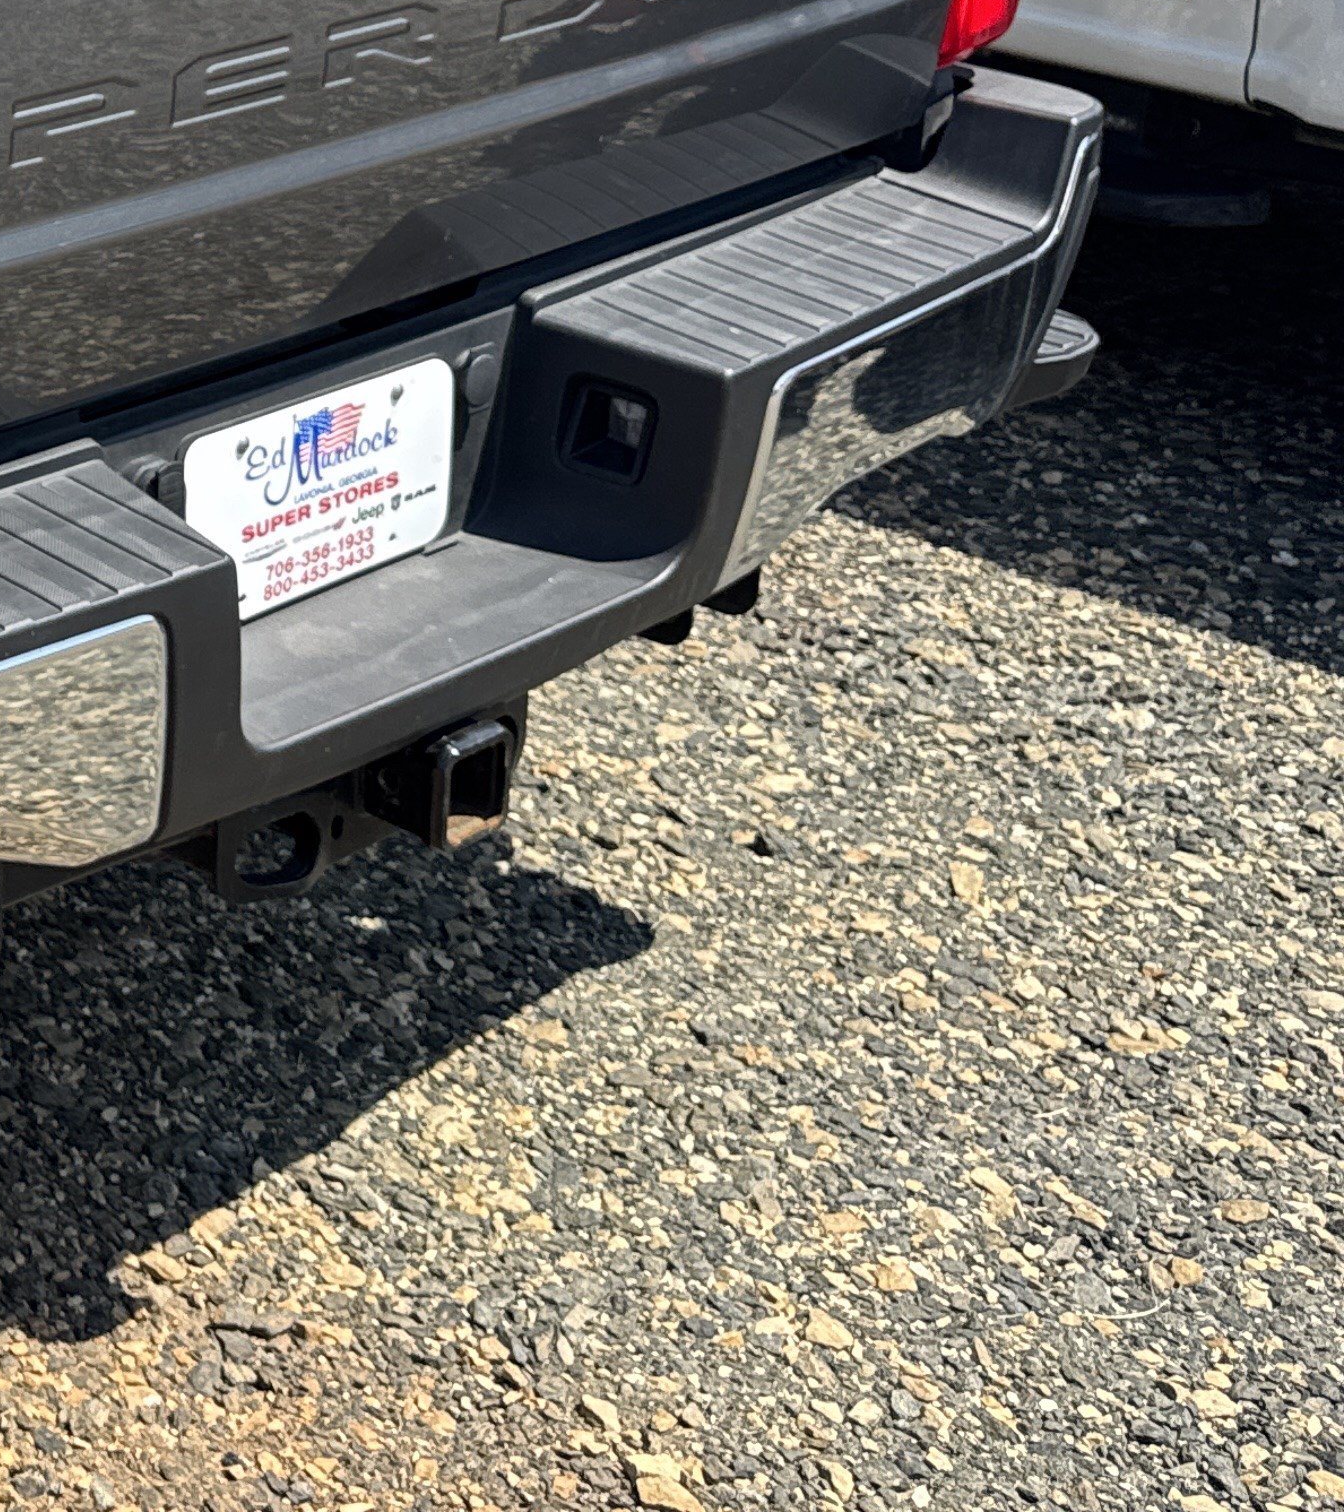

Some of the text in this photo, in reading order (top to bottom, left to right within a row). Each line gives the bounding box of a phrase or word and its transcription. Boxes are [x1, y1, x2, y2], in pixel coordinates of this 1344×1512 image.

[244, 417, 398, 506] Ed Murdock
[241, 503, 312, 544] SUPER
[318, 471, 400, 515] STORES
[352, 502, 385, 525] Jeep
[263, 543, 375, 602] 800-453-3433
[265, 525, 375, 581] 706-356-1933
